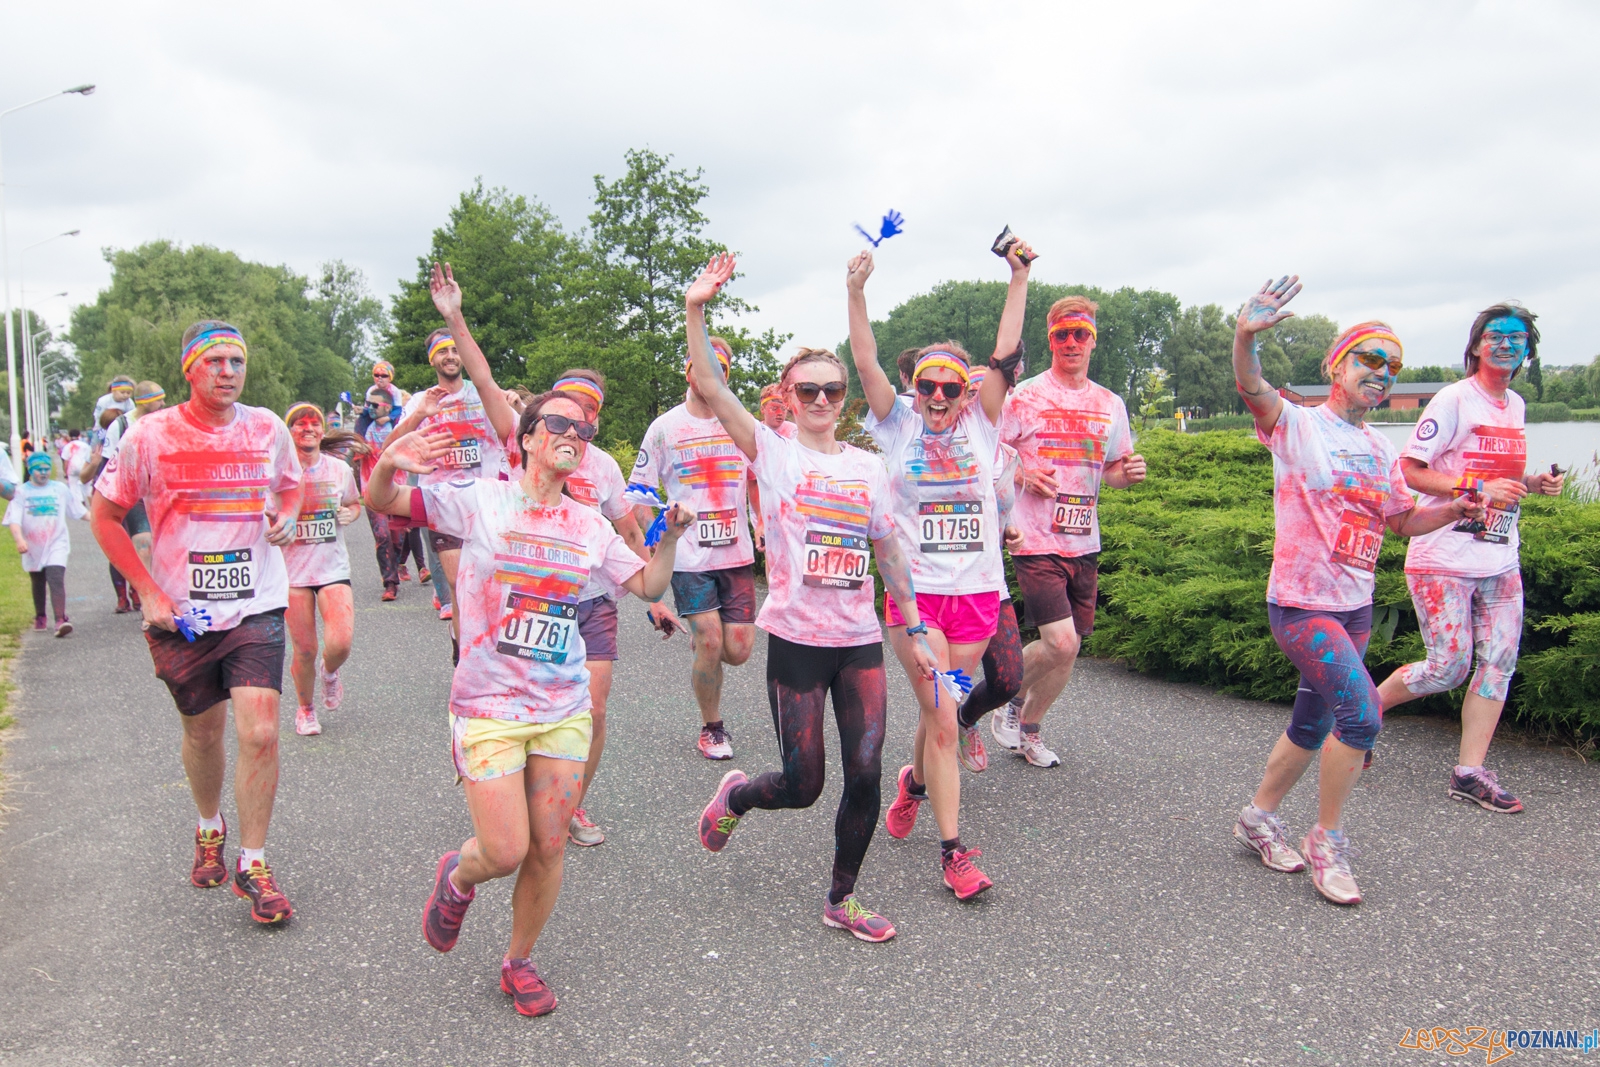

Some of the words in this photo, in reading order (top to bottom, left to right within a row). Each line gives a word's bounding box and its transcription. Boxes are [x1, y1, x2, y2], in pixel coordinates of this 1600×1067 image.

[680, 447, 696, 461] THE
[696, 444, 722, 458] COLOR
[949, 446, 966, 458] RUN
[1478, 437, 1497, 452] THE
[444, 448, 478, 464] 01763
[242, 464, 266, 479] RUN
[923, 505, 935, 513] THE
[934, 504, 954, 513] COLOR
[954, 503, 967, 513] RUN
[1055, 506, 1093, 526] 01758
[296, 521, 334, 538] 01762
[700, 520, 737, 539] 01757
[923, 518, 980, 540] 01759
[810, 533, 822, 544] THE
[821, 535, 842, 546] COLOR
[842, 537, 854, 547] RUN
[193, 554, 204, 563] THE
[204, 554, 224, 564] COLOR
[224, 553, 237, 563] RUN
[508, 540, 527, 556] THE
[528, 544, 561, 562] COLOR
[562, 550, 581, 567] RUN
[807, 549, 866, 578] 01760
[192, 565, 251, 590] 02586
[548, 604, 563, 616] RUN
[504, 614, 571, 651] 01761
